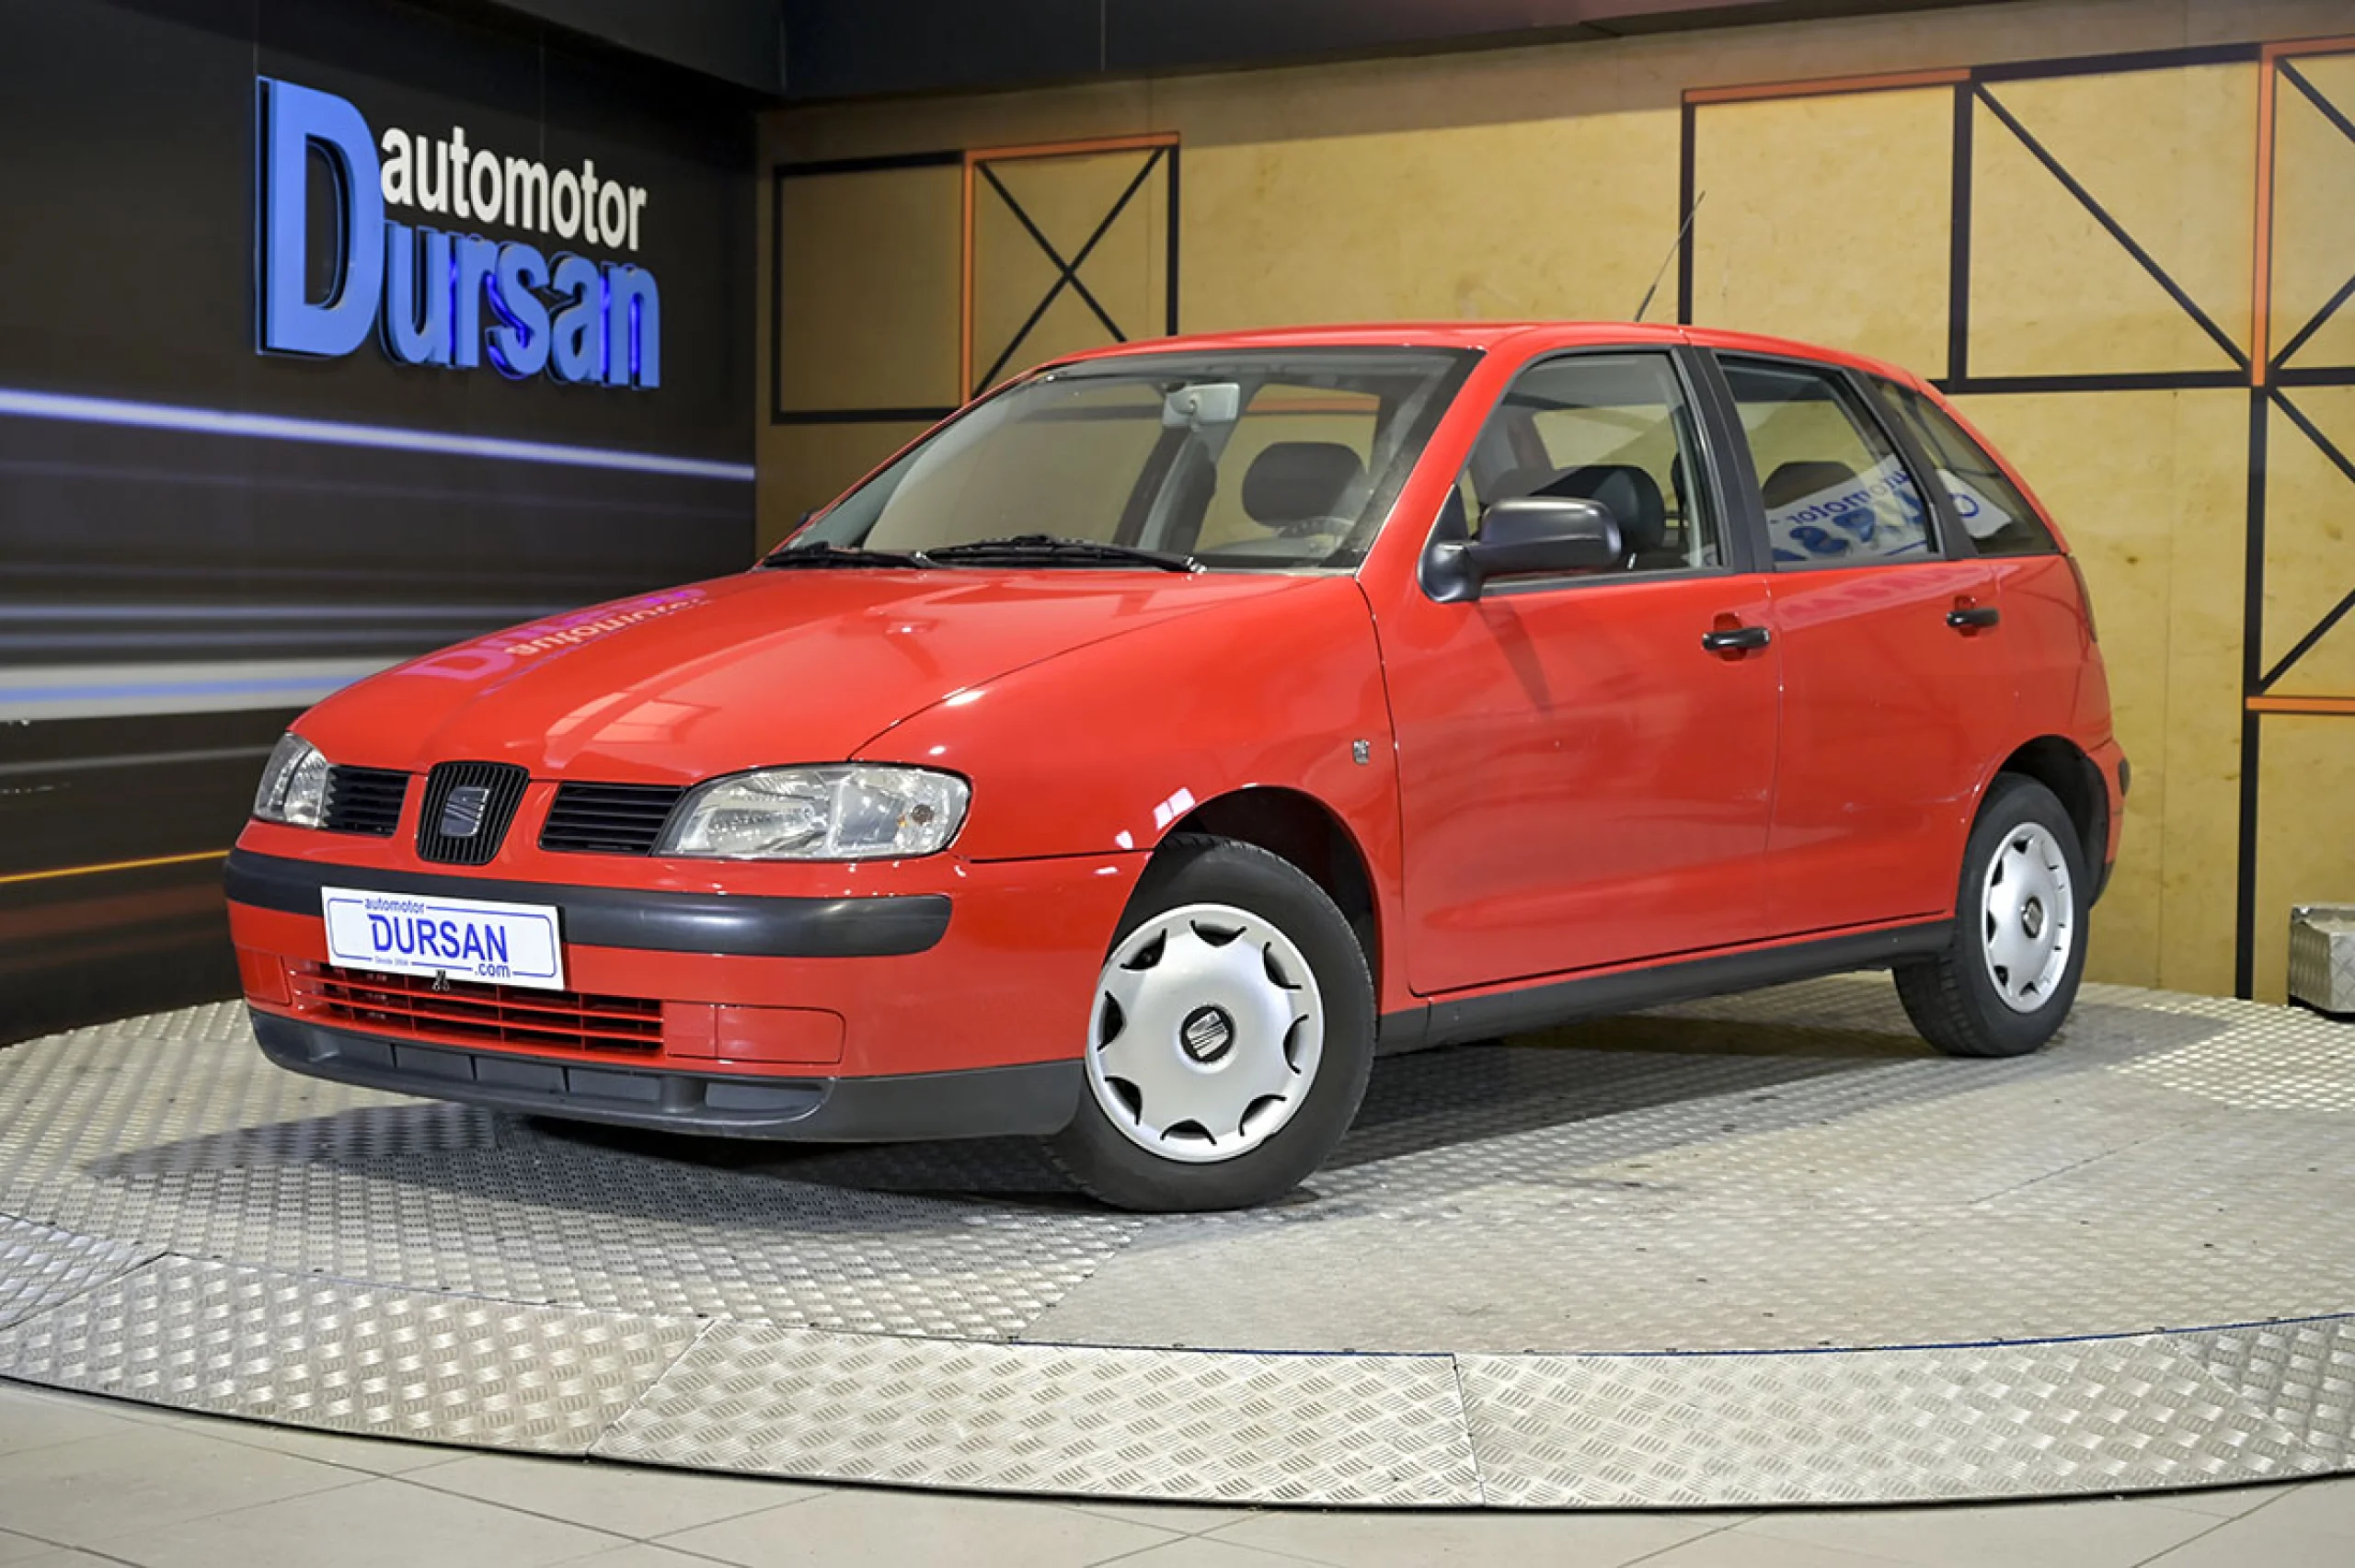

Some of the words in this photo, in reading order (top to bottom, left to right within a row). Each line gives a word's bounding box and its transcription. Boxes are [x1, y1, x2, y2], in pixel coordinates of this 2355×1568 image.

[381, 126, 647, 251] automotor
[256, 74, 660, 391] Dursan
[365, 897, 425, 914] automotor
[368, 913, 508, 963] DURSAN
[475, 963, 511, 978] .com
